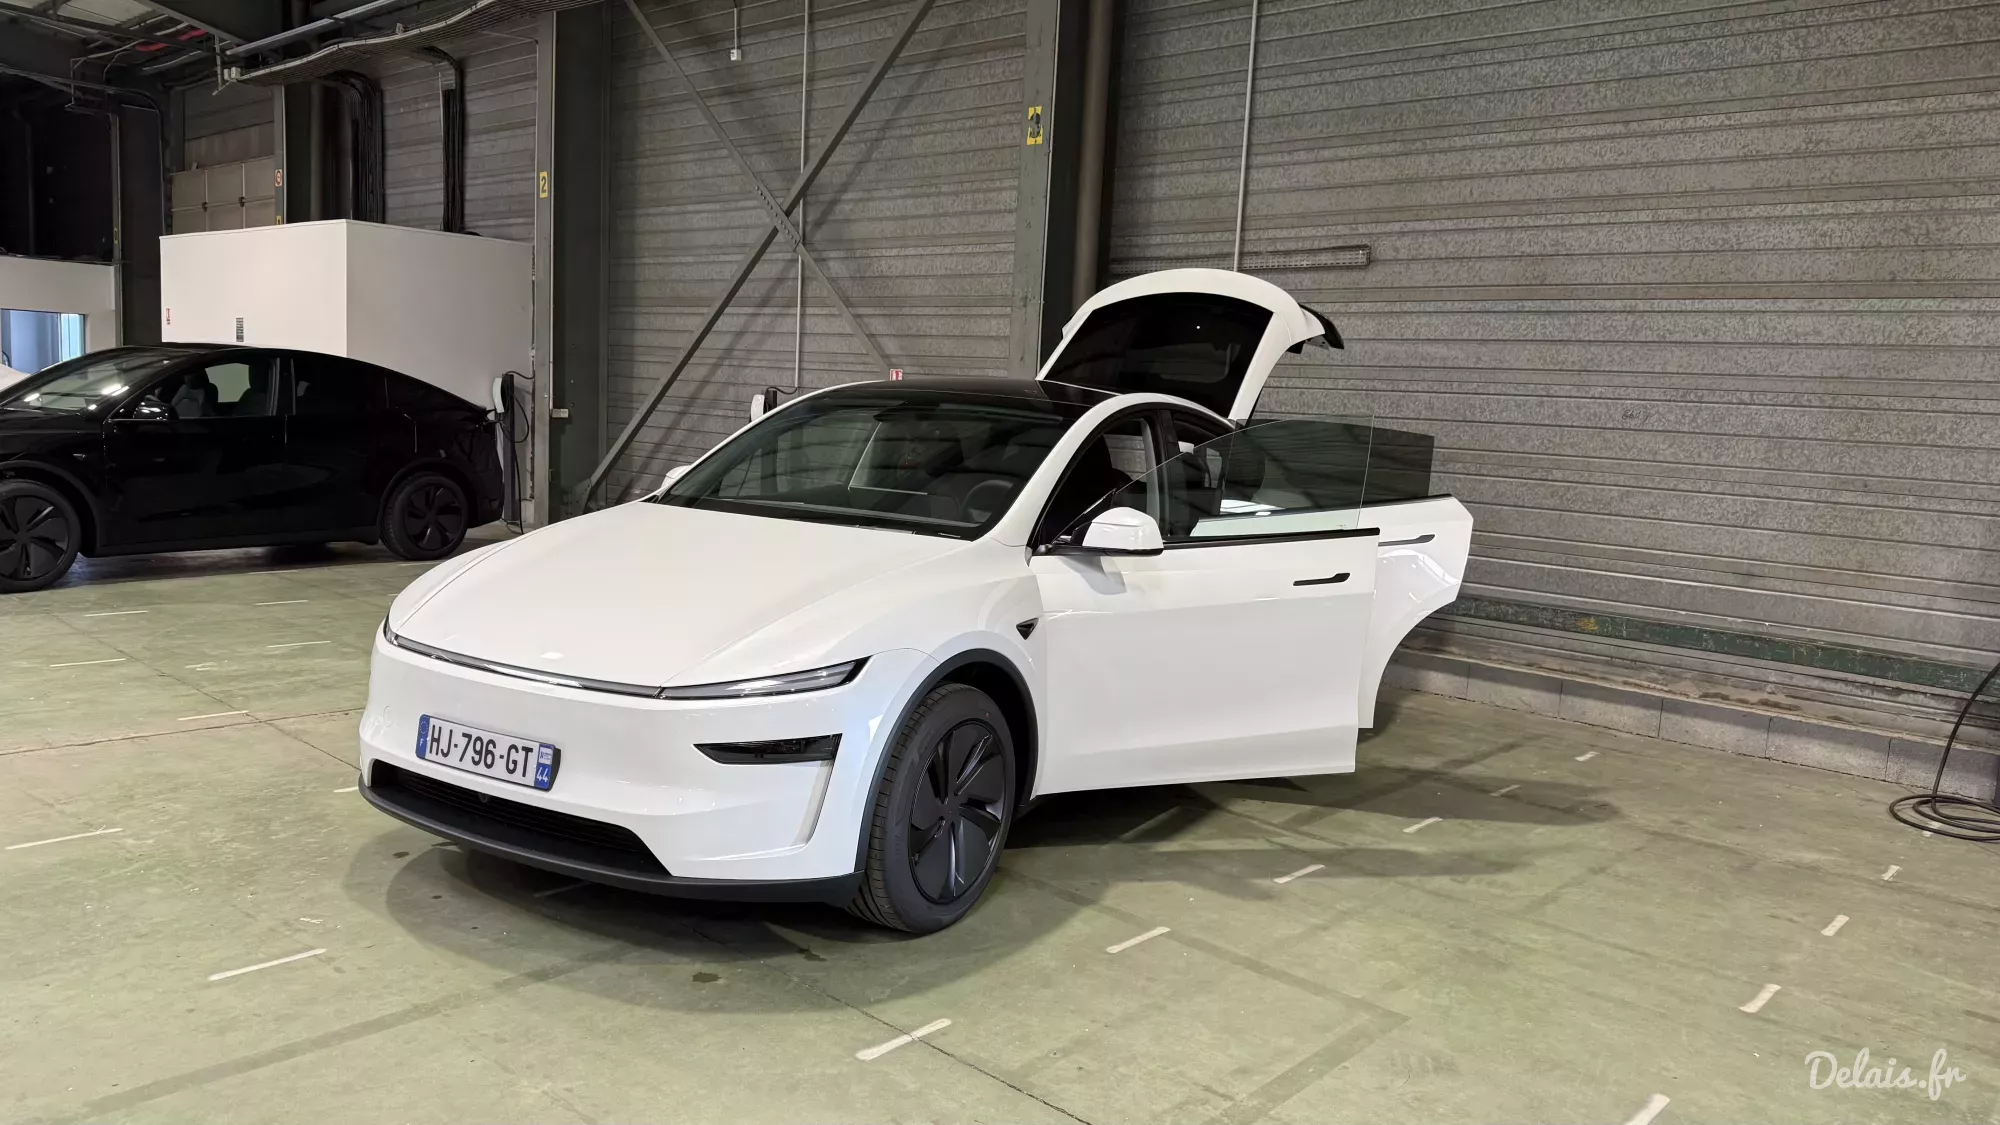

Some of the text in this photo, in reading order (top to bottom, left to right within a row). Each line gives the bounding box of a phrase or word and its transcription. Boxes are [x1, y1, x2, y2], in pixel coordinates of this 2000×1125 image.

[541, 175, 547, 194] 2
[429, 724, 534, 778] HJ-796-GT
[536, 766, 549, 783] 44
